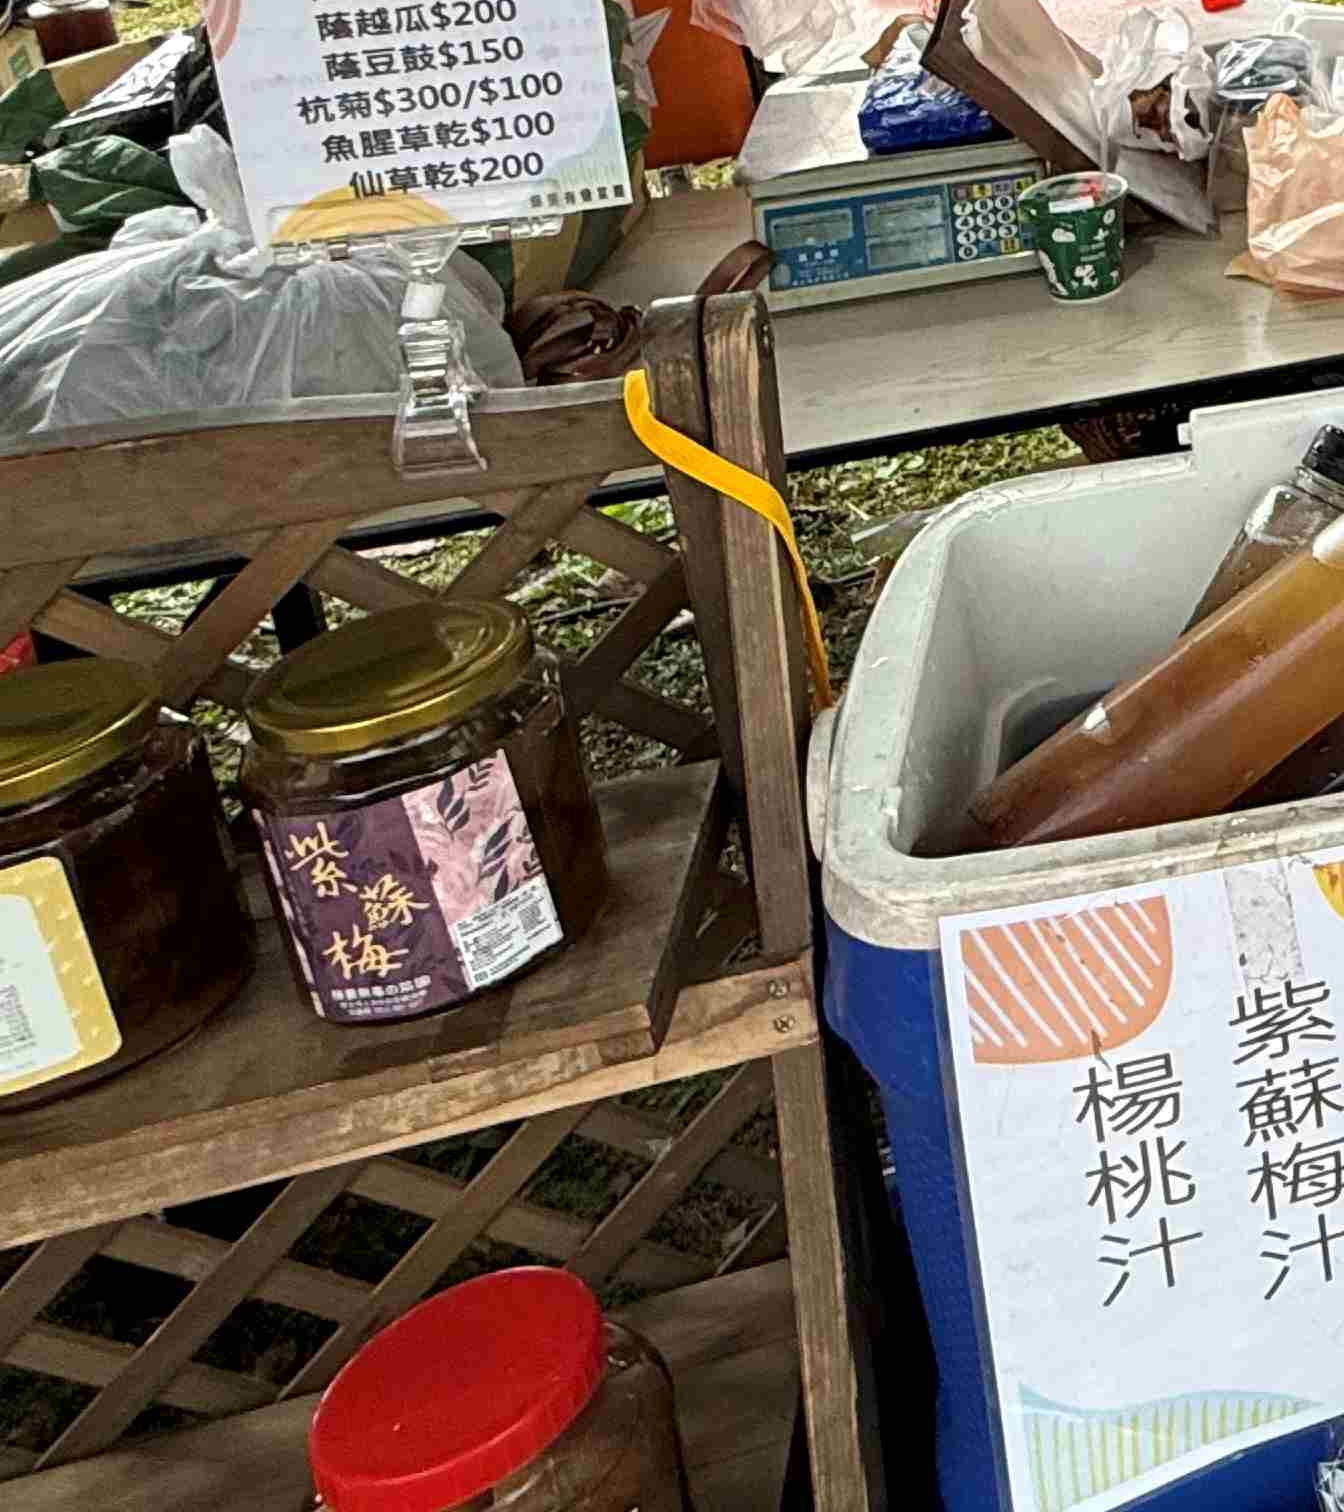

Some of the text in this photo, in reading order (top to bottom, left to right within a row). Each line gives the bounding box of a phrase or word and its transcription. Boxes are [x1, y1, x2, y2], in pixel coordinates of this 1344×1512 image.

[322, 35, 524, 81] 蔭豆鼓$150
[296, 71, 563, 125] 杭菊$300/$100
[321, 111, 555, 163] 魚腥草乾$100
[349, 152, 544, 198] 仙草乾$200
[284, 822, 431, 979] 紫蘇梅
[1072, 1050, 1203, 1307] 楊桃汁
